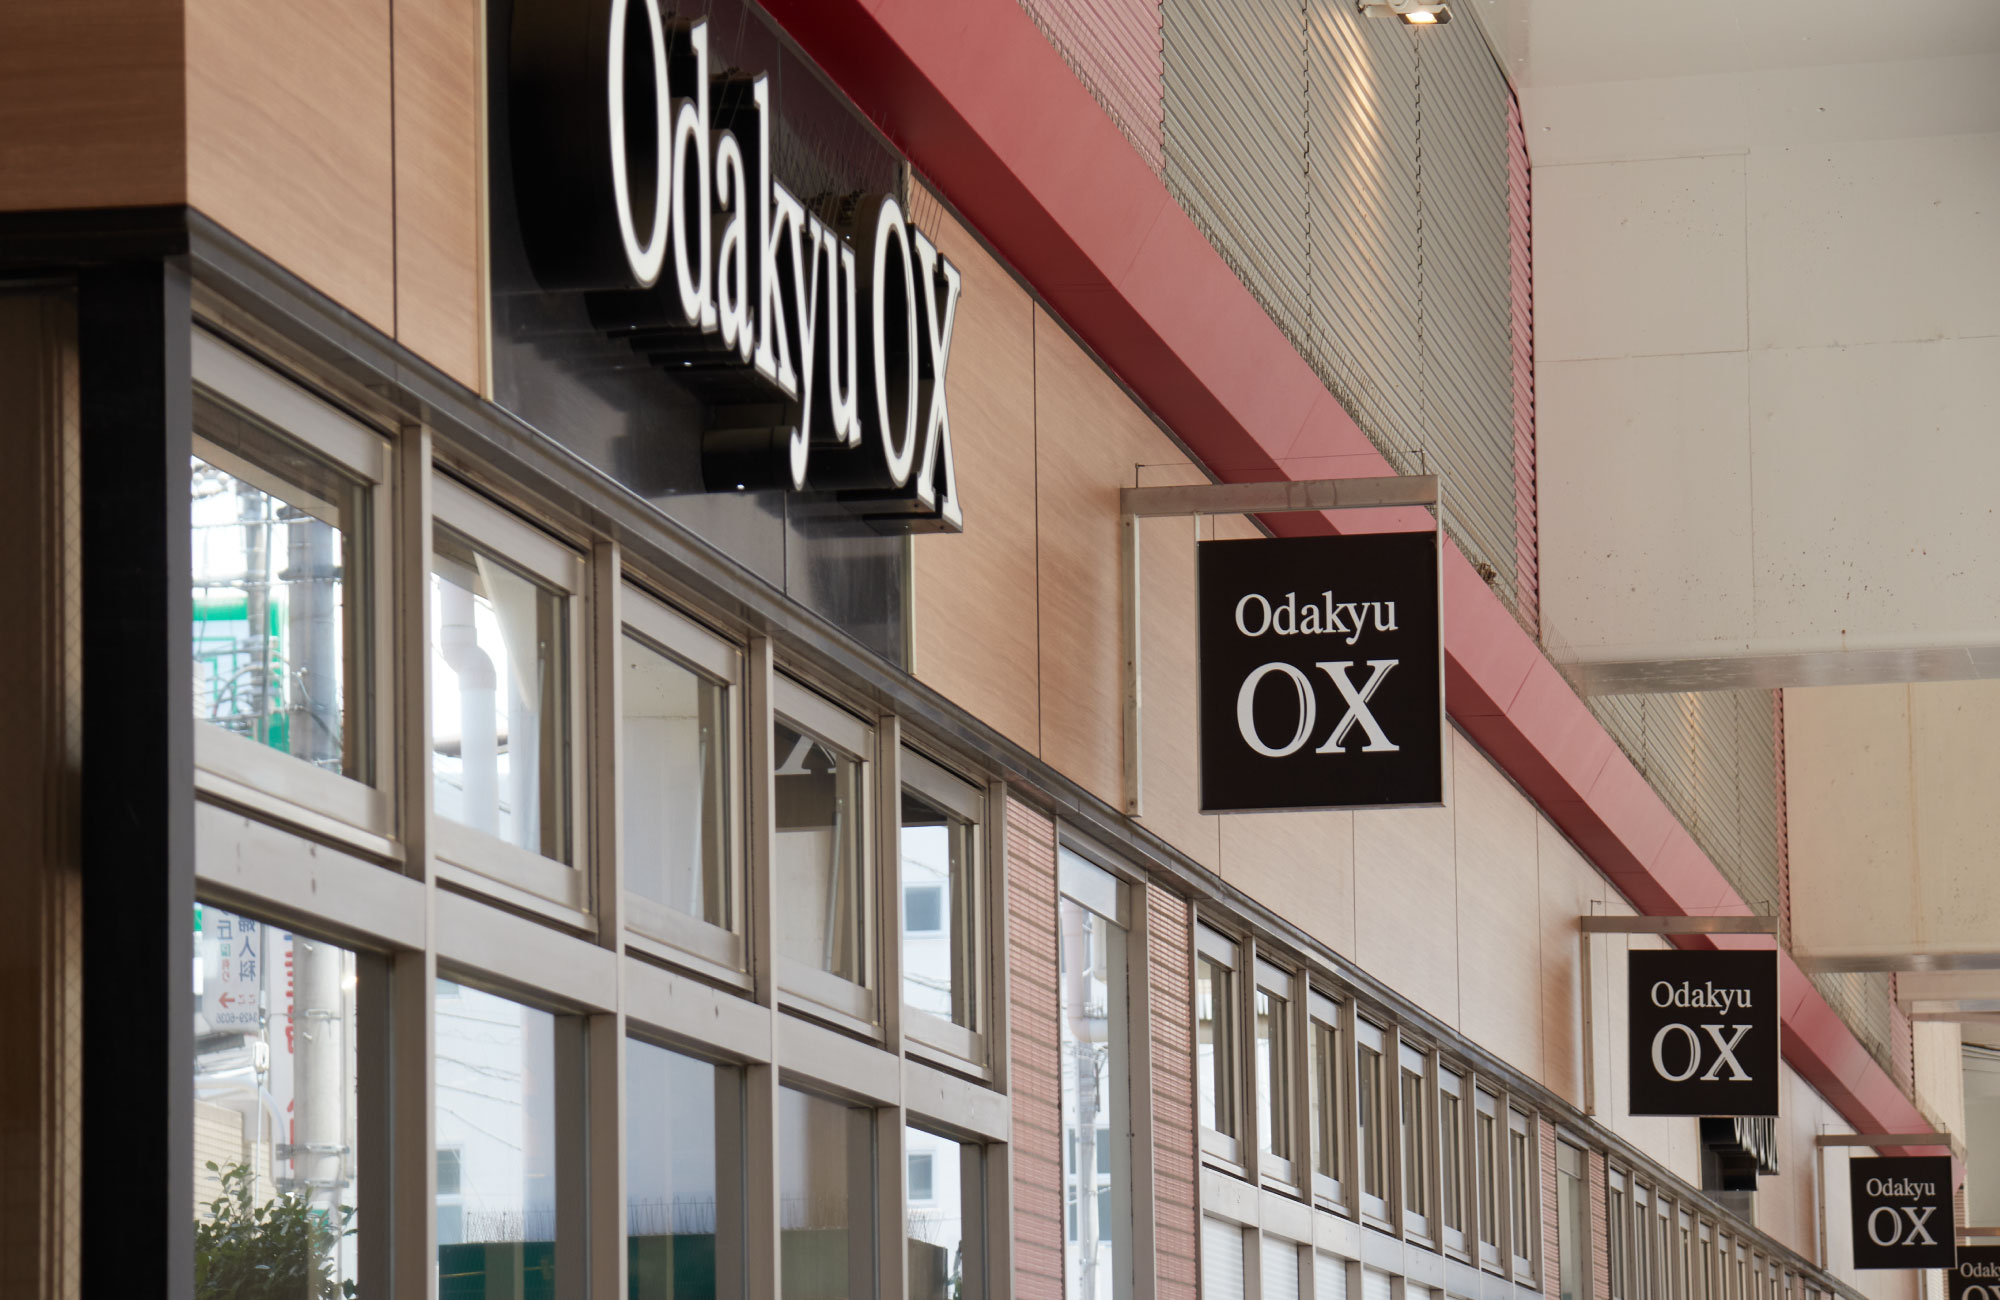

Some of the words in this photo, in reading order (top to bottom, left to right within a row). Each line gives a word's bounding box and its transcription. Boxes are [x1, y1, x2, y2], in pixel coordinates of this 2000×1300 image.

[608, 0, 862, 490] Odakyu
[873, 194, 963, 533] OX
[1235, 590, 1399, 645] Odakyu
[1236, 659, 1400, 757] OX
[1651, 980, 1753, 1016] Odakyu
[1651, 1023, 1753, 1082] OX
[1866, 1178, 1936, 1201] Odakyu
[1867, 1206, 1938, 1247] OX
